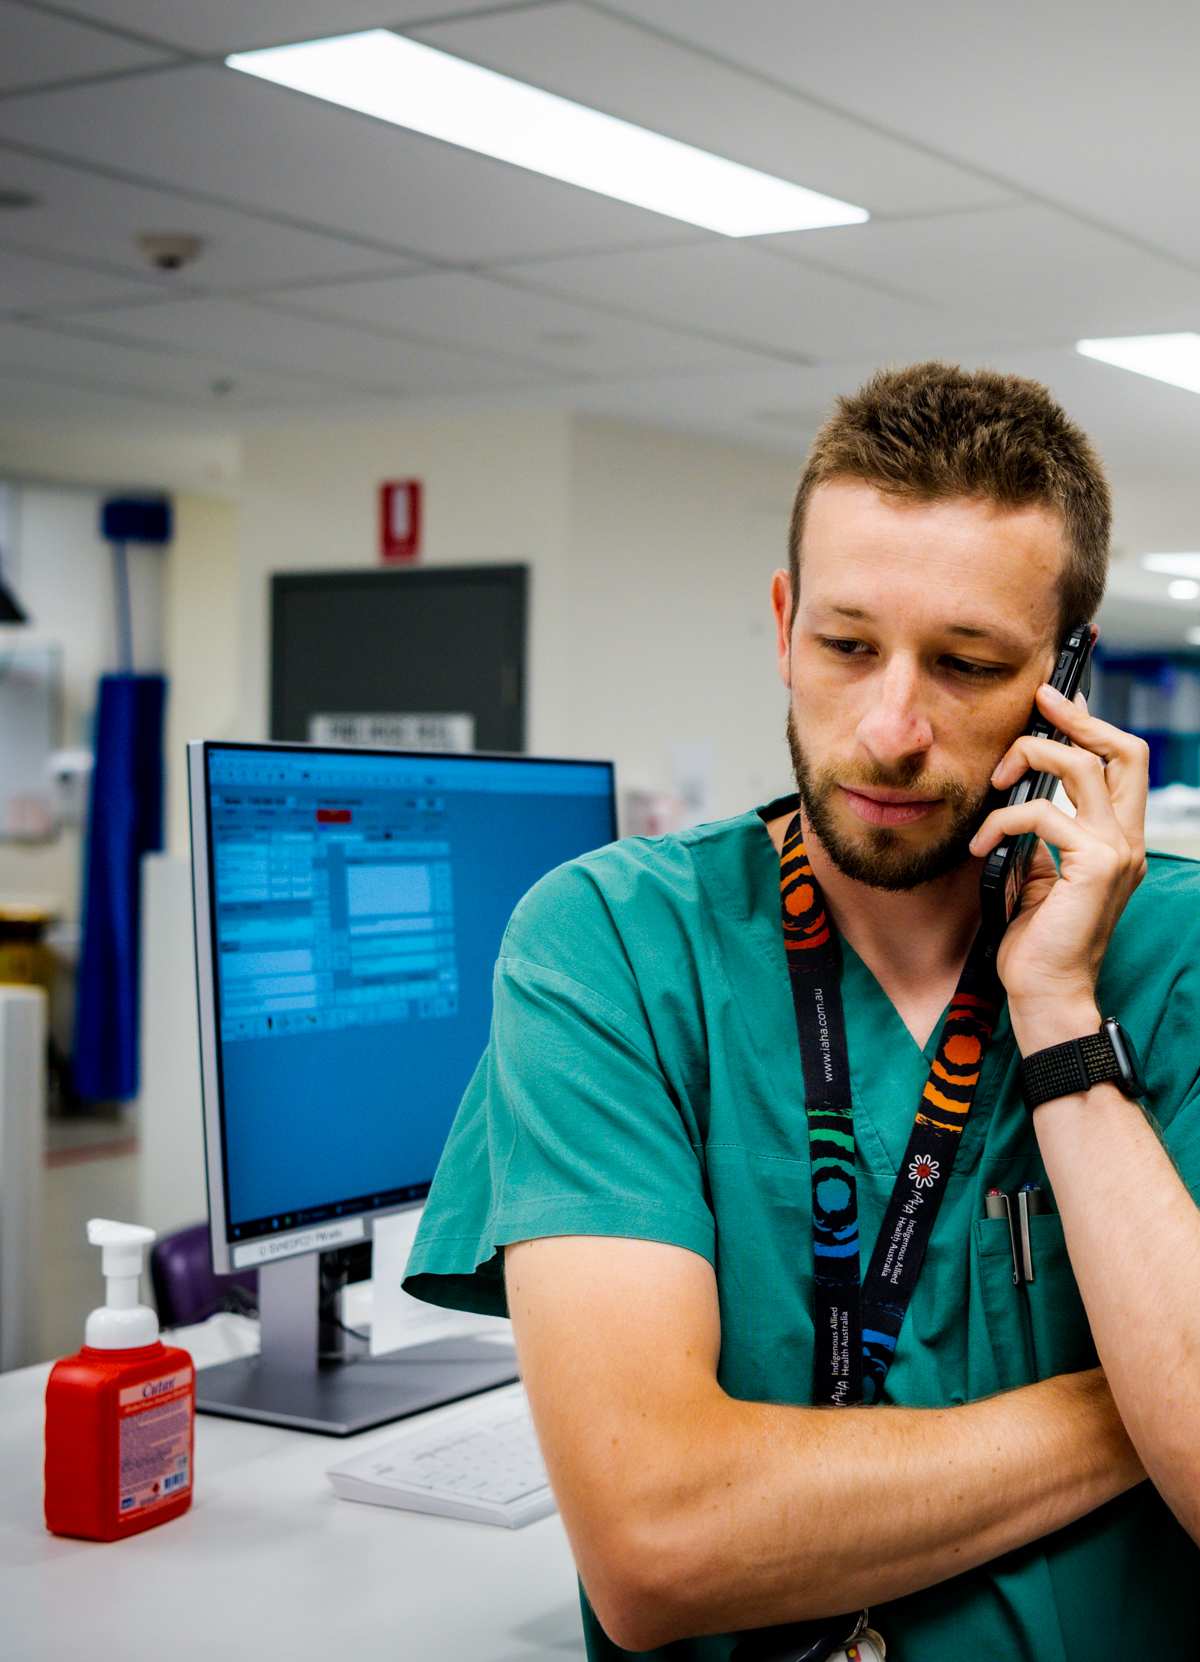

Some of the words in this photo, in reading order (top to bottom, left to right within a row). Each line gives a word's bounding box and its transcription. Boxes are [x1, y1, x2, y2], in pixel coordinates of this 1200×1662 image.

[814, 988, 833, 1082] www.iaha.com.au
[892, 1216, 907, 1242] Health
[898, 1220, 917, 1261] Indigenous
[881, 1242, 899, 1277] Australia
[890, 1261, 904, 1285] Allied
[830, 1306, 839, 1329] Allied
[840, 1311, 849, 1347] Australia
[831, 1331, 840, 1376] Indigenous
[841, 1348, 849, 1376] Health
